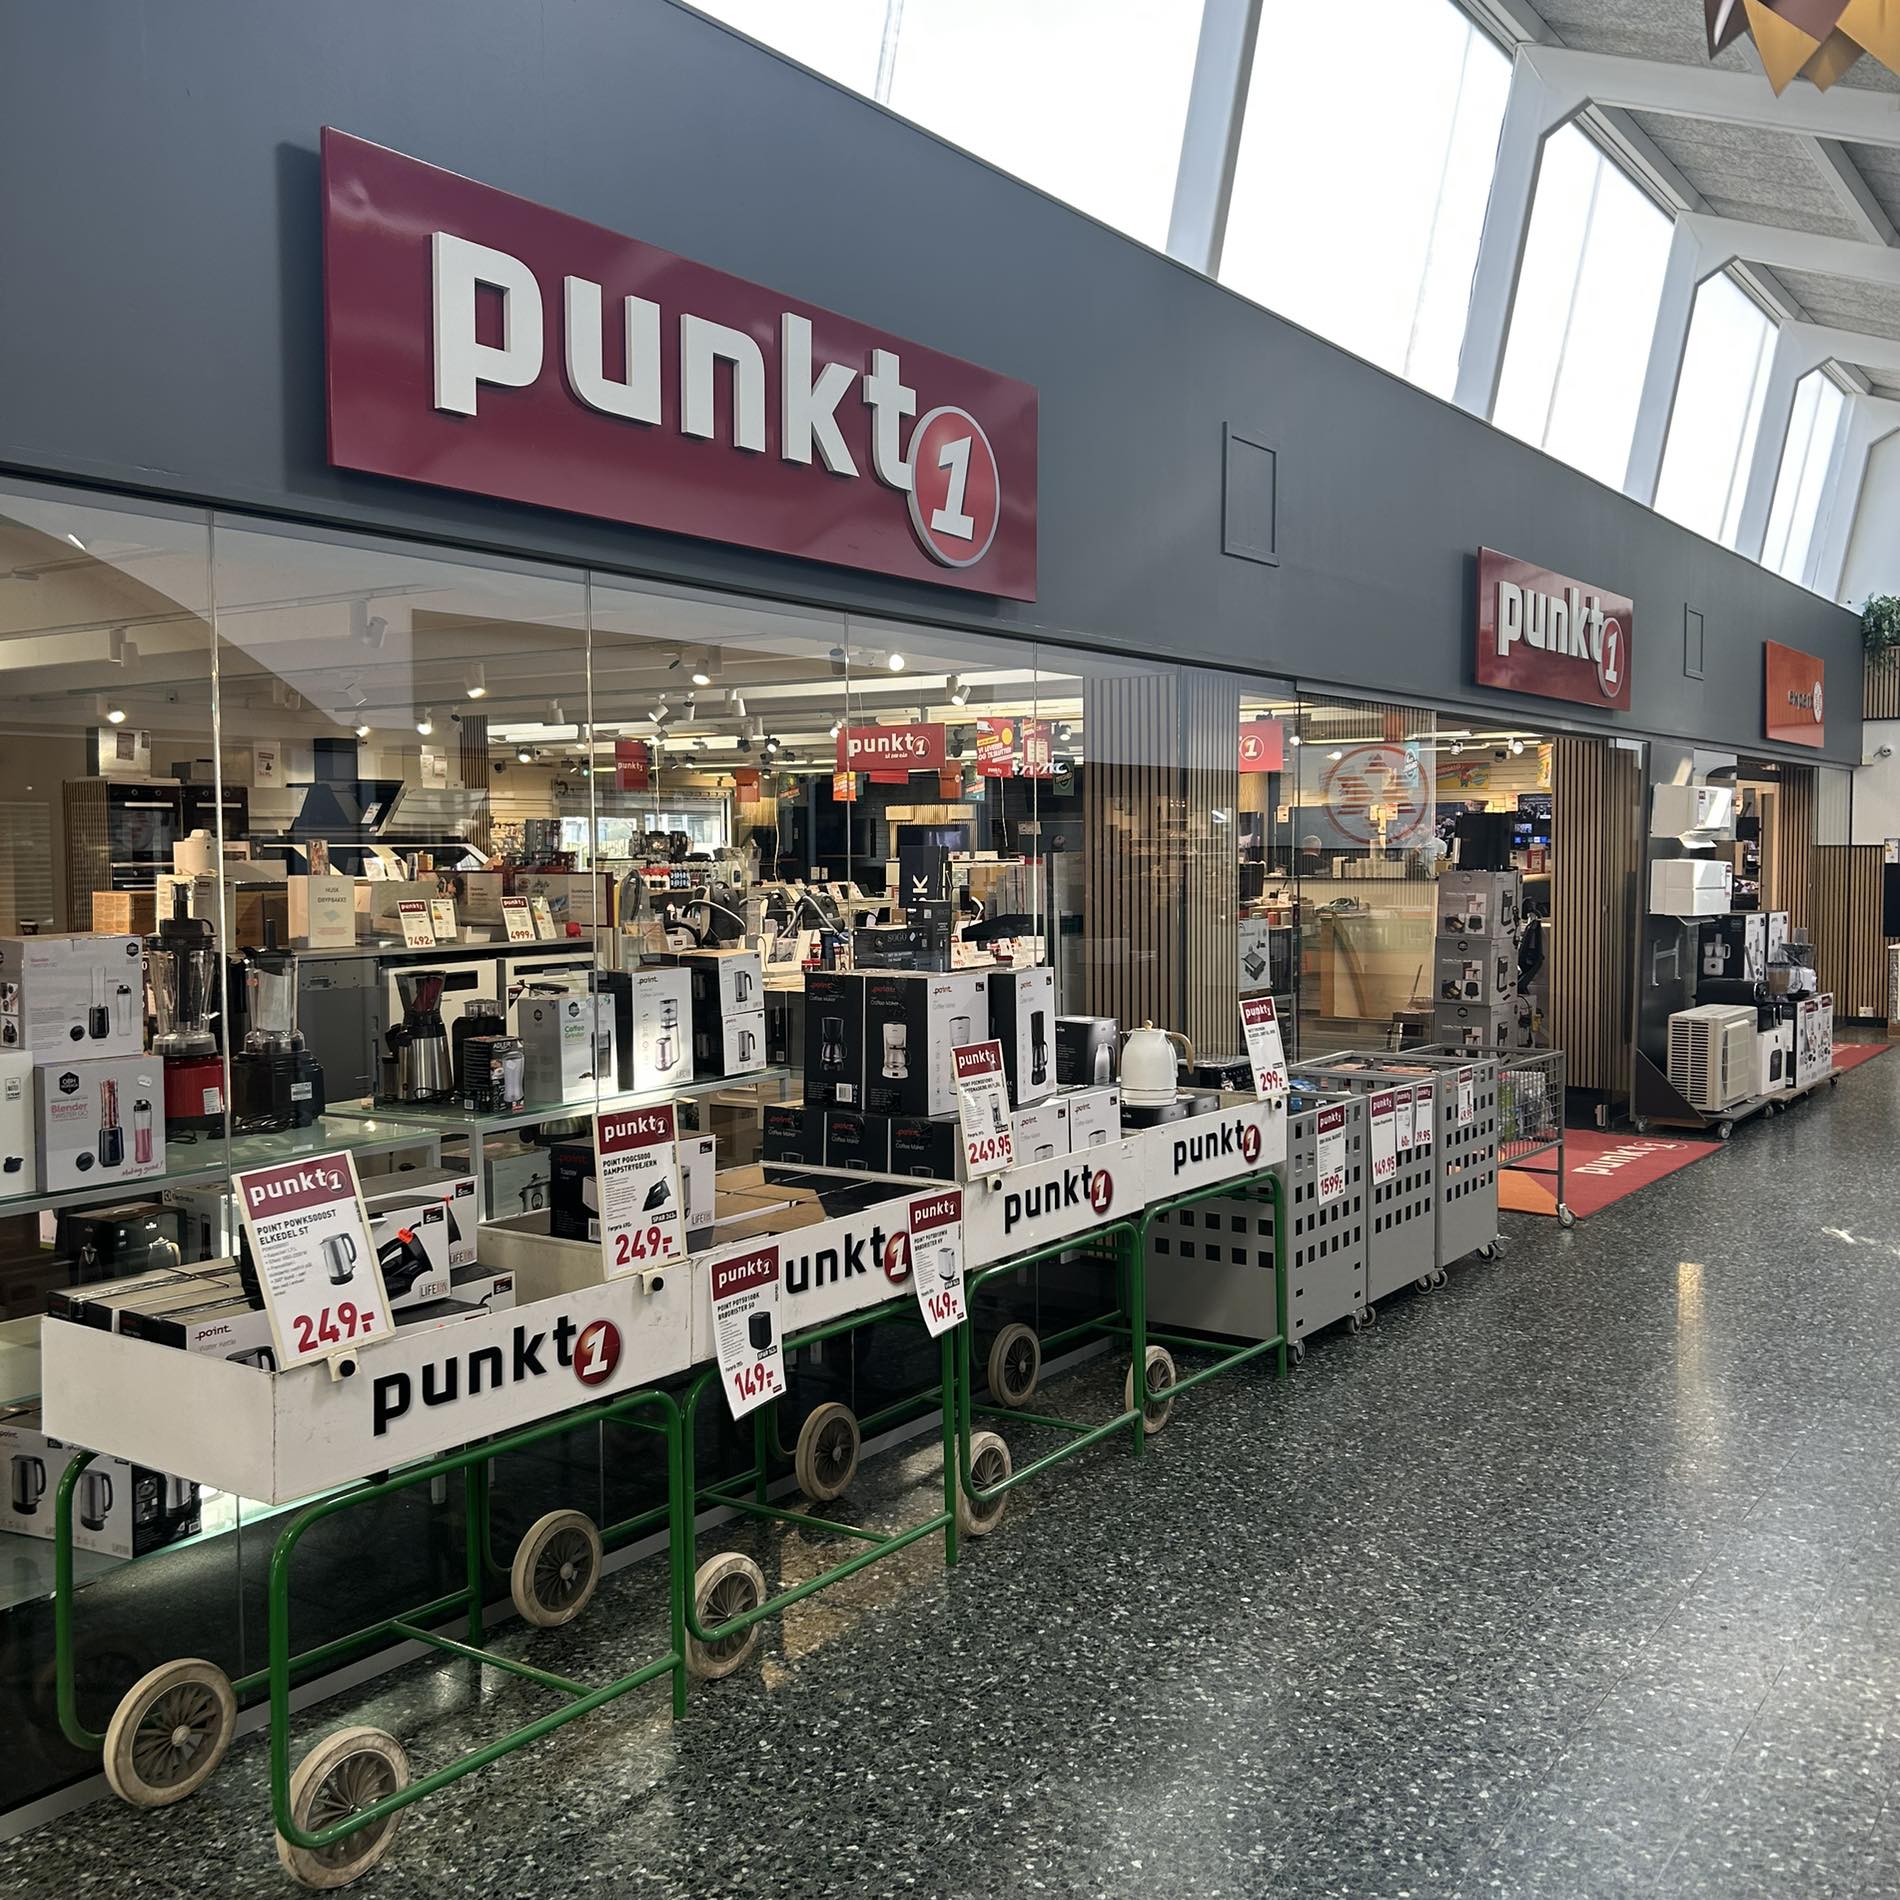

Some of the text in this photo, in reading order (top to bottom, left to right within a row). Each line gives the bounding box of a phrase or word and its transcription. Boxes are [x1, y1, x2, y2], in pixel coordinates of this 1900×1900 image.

[257, 1222, 282, 1236] POINT
[260, 1226, 309, 1246] ELKEDEL ST
[785, 1226, 911, 1294] unkt1
